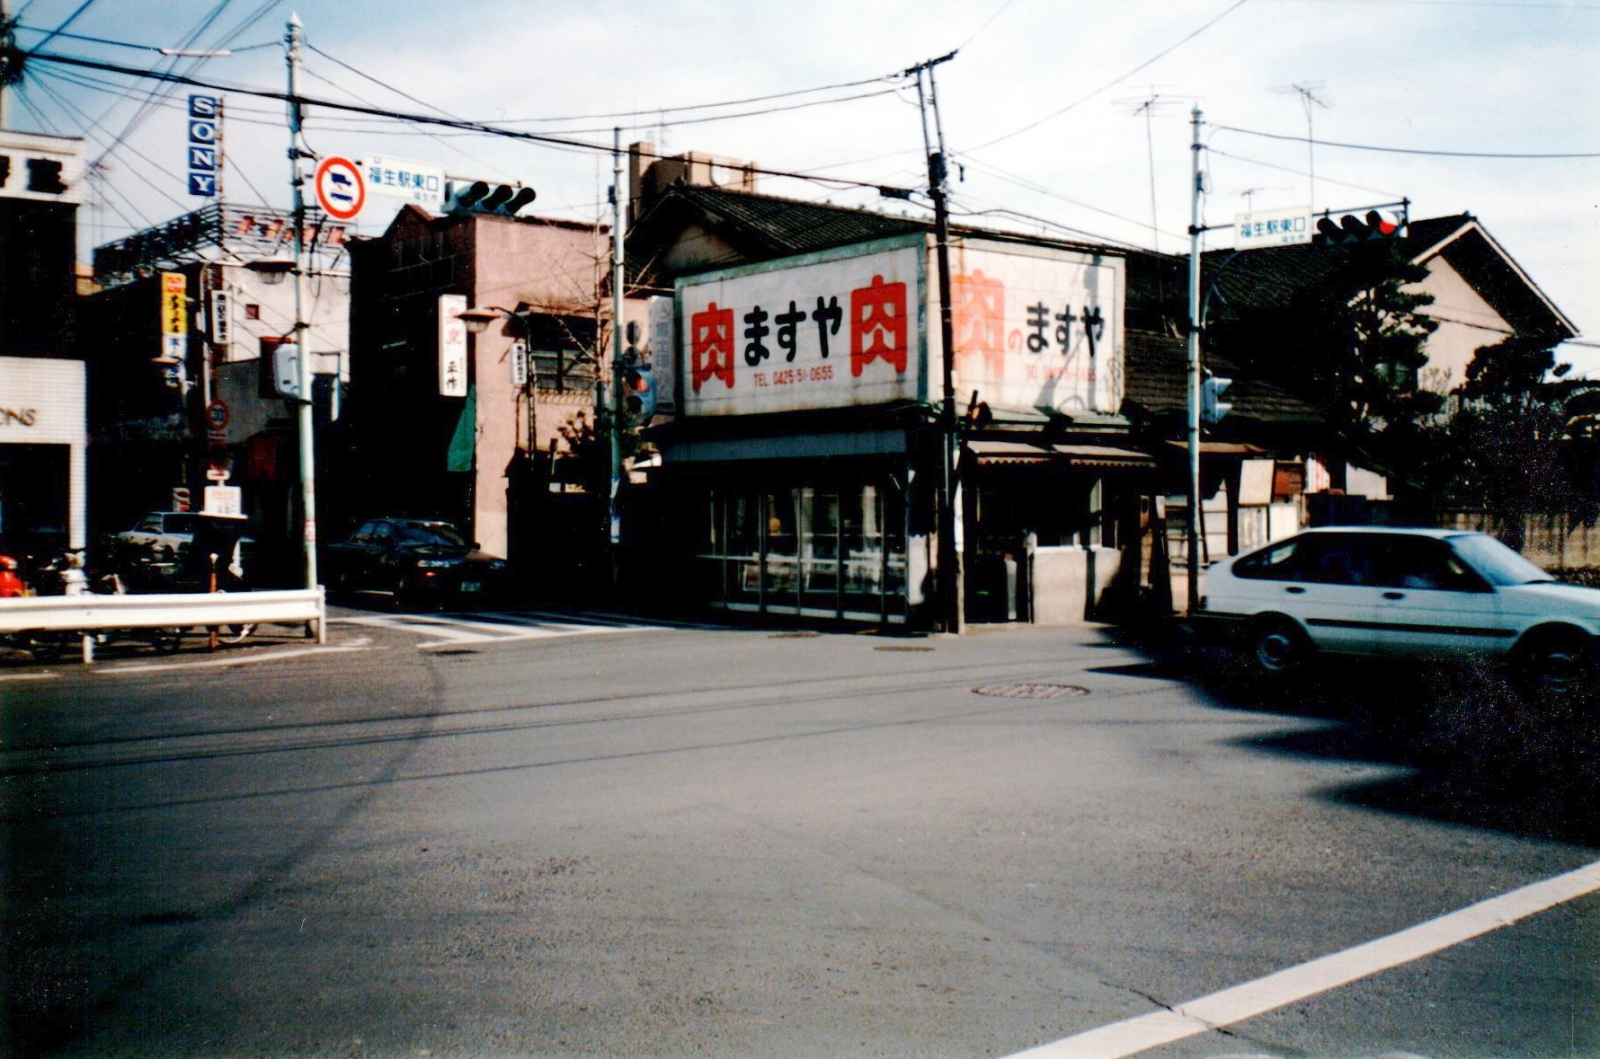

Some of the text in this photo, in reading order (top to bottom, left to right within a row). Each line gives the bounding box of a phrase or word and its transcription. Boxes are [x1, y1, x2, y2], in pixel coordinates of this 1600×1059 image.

[192, 97, 214, 192] SONY
[368, 166, 438, 192] 福生駅東口
[1241, 216, 1305, 238] 福生駅東口
[743, 295, 843, 367] ますや
[753, 373, 769, 388] TEL
